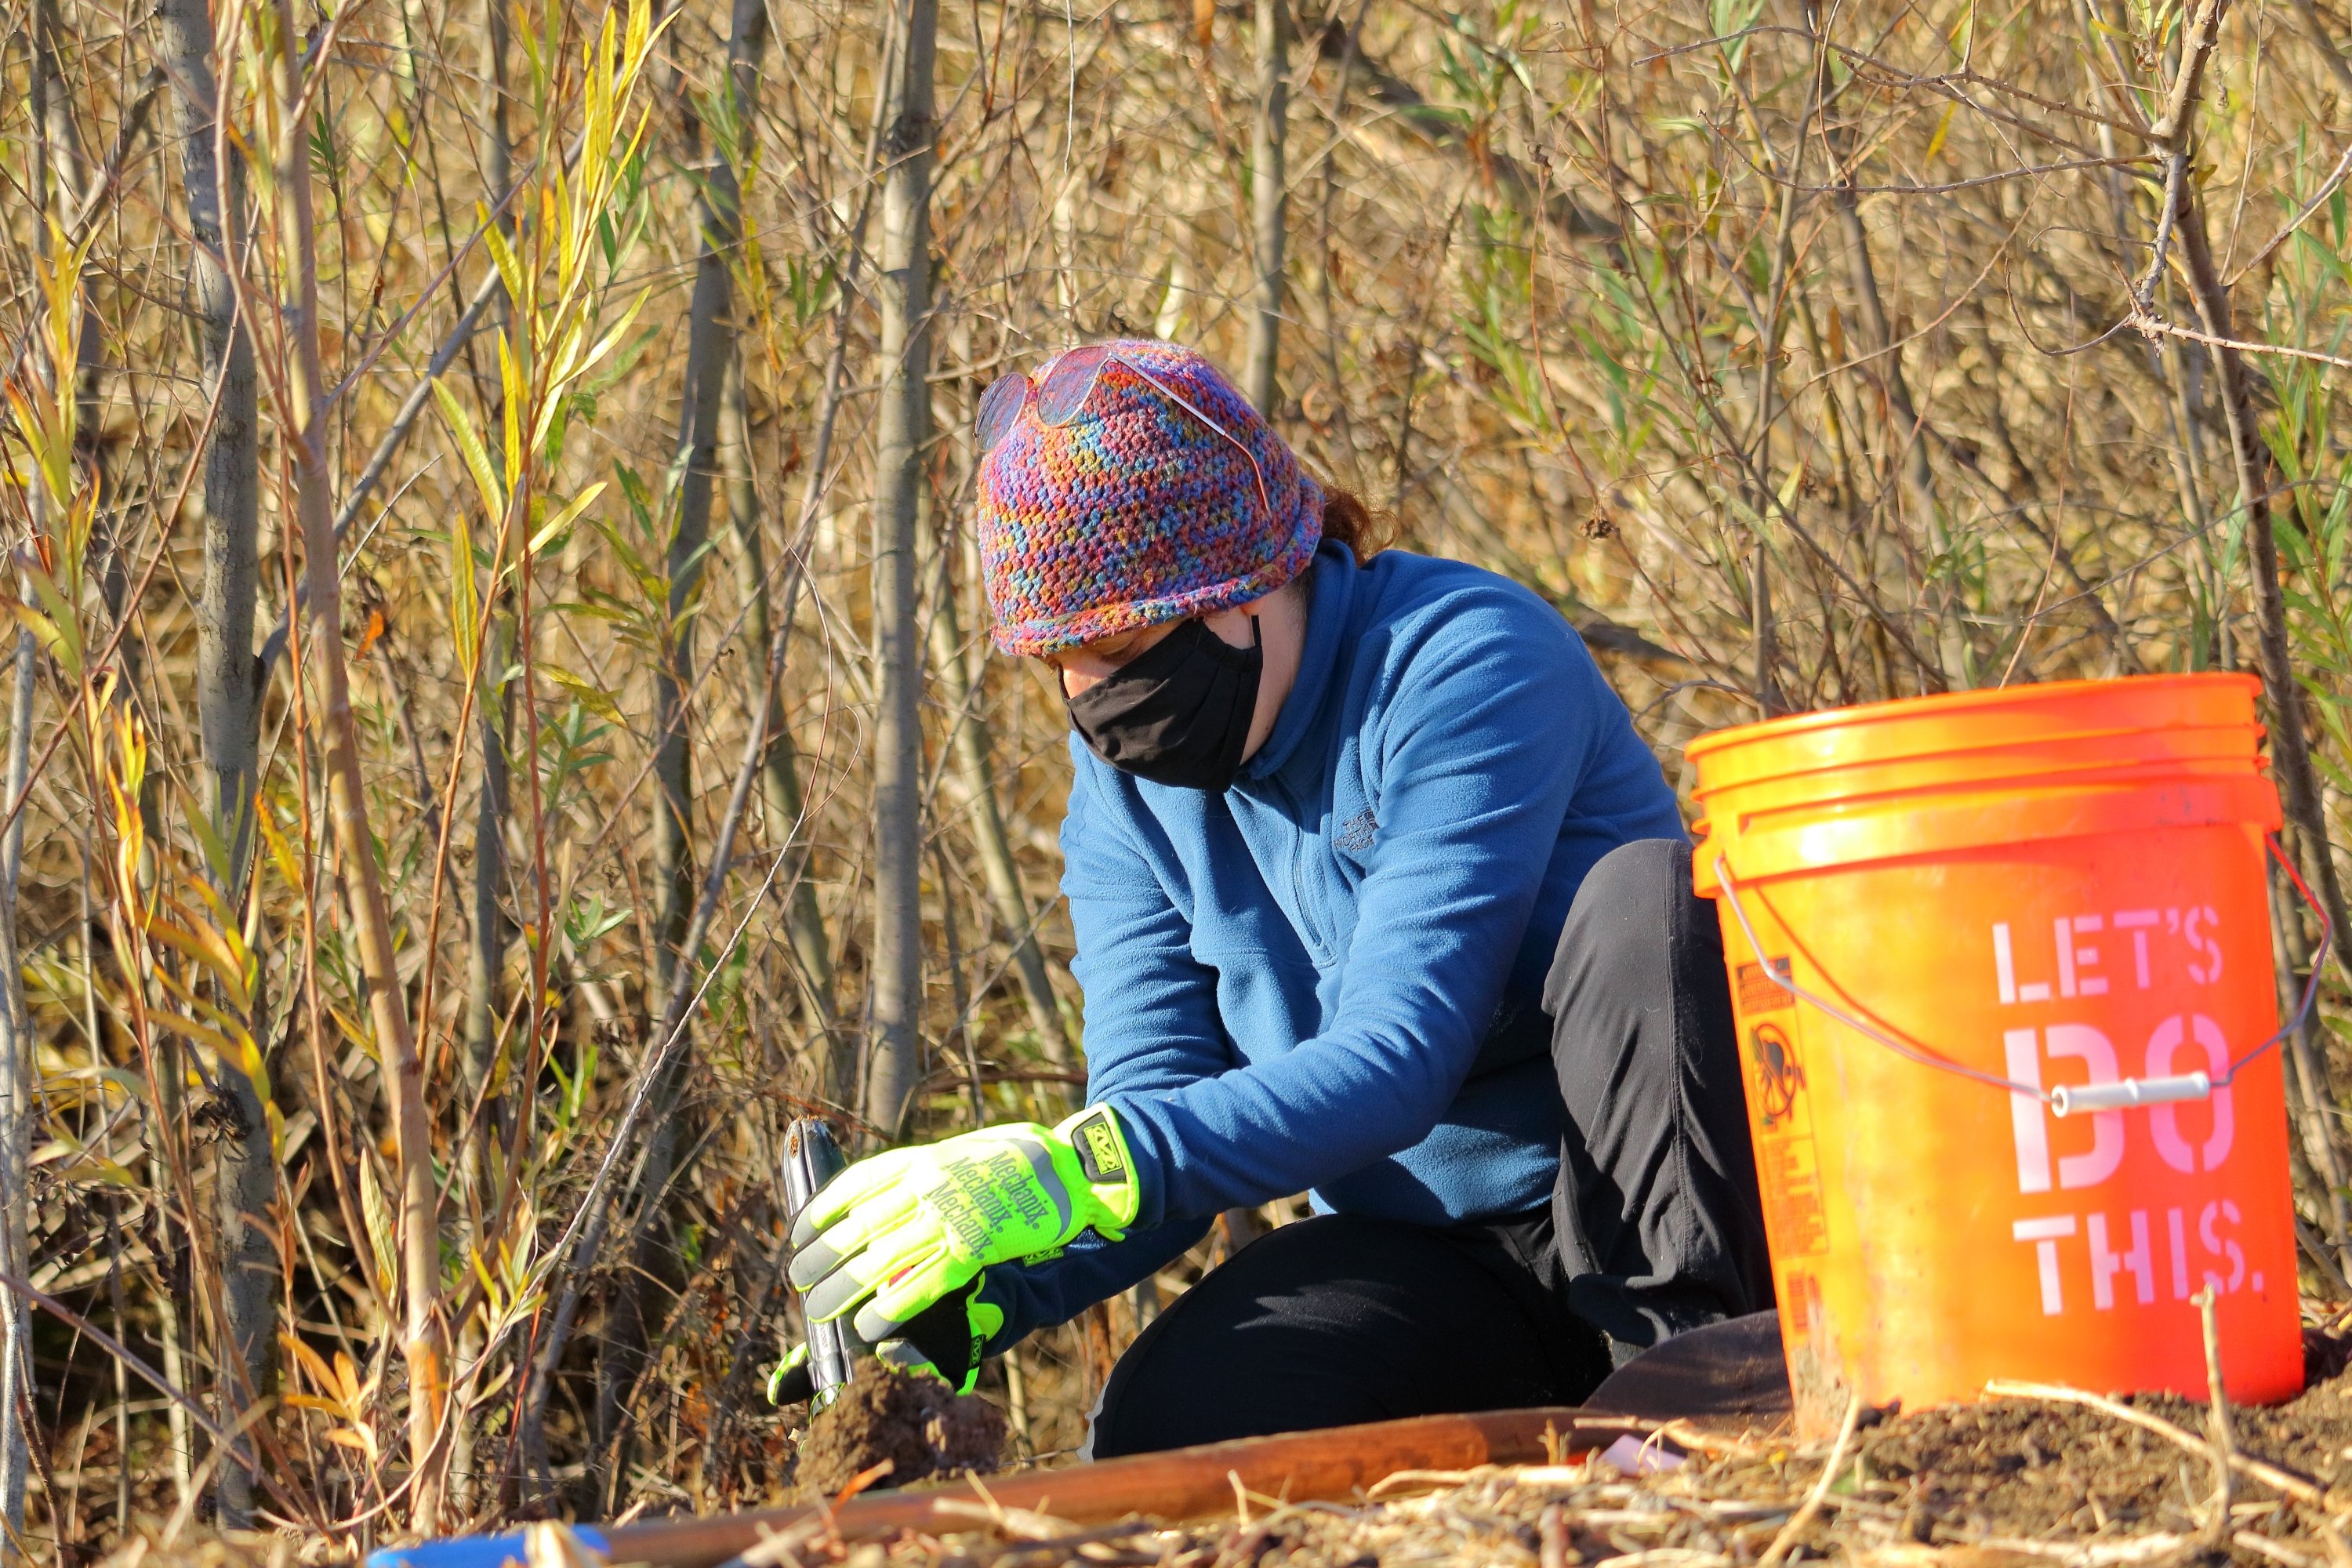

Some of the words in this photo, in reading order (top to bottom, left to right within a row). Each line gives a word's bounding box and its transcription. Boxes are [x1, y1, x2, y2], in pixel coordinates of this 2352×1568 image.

[1334, 823, 1374, 849] NORTH
[1342, 815, 1367, 832] THE
[1992, 906, 2223, 1004] LET'S
[2003, 1012, 2235, 1194] DO
[2013, 1199, 2265, 1316] THIS.
